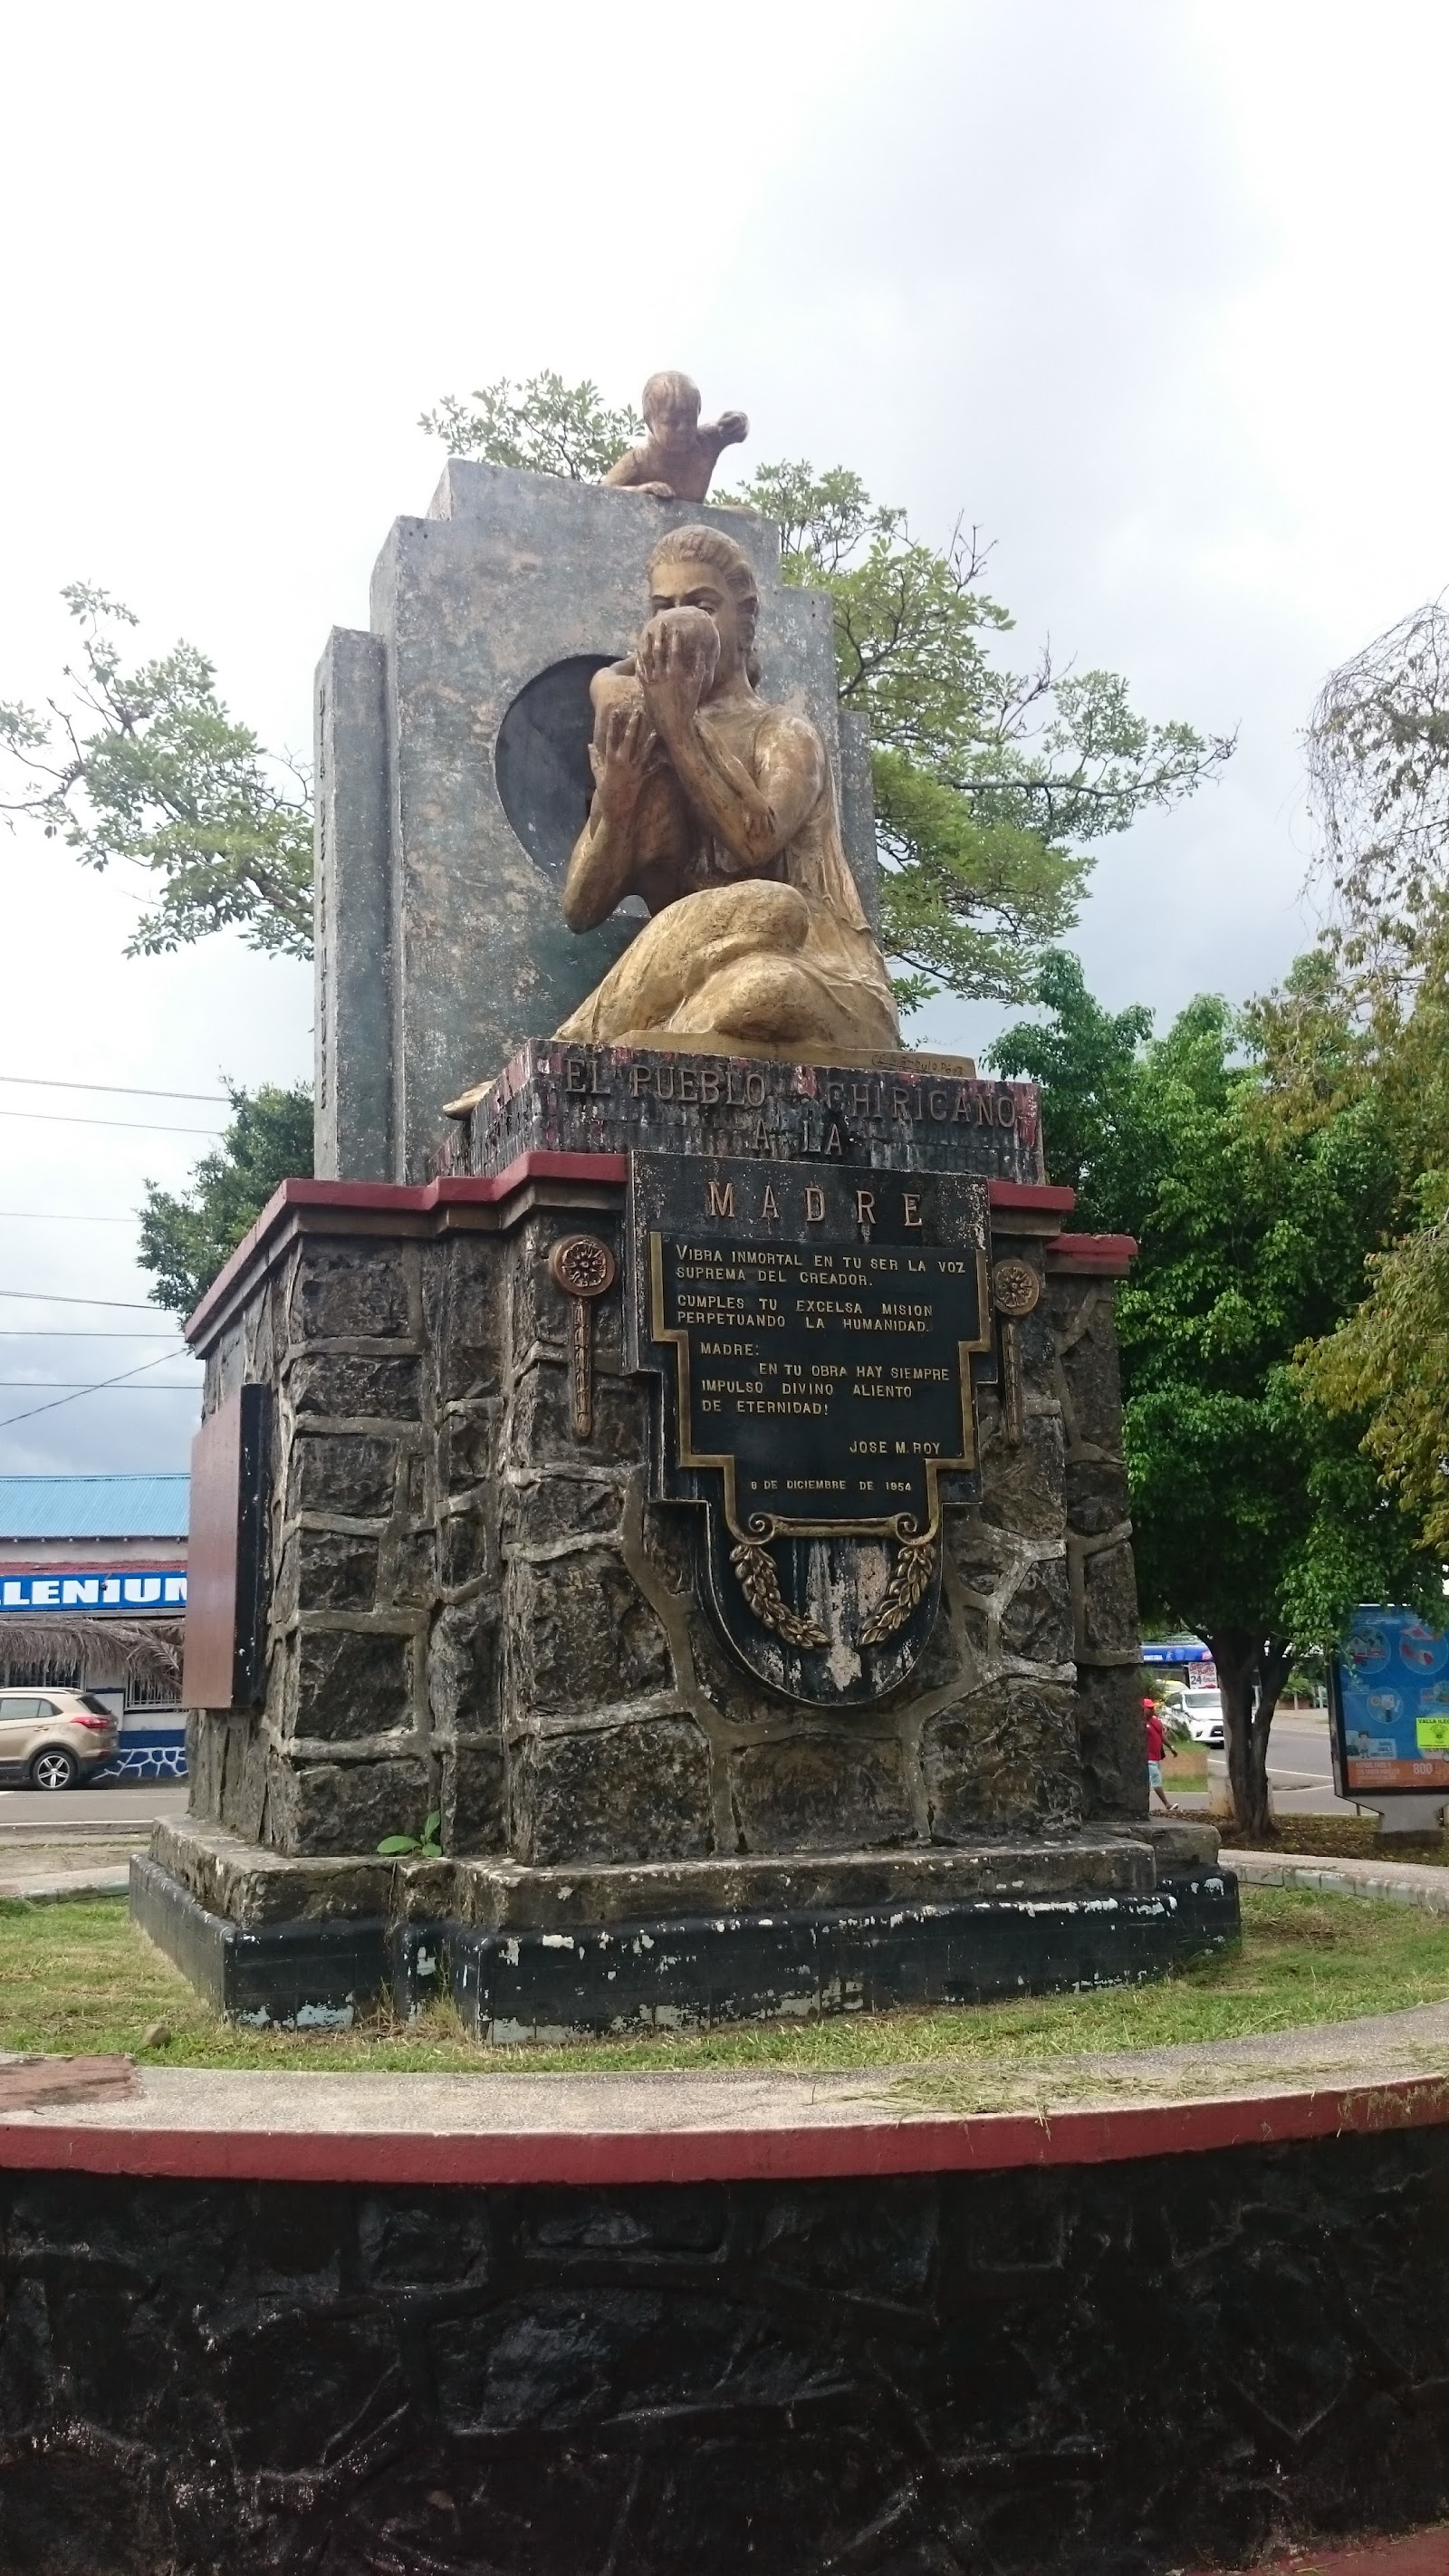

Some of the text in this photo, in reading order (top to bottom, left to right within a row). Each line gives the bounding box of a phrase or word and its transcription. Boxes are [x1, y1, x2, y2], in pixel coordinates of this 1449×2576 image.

[565, 1058, 1016, 1129] EL PUEBLO CHIRICANO
[754, 1118, 842, 1156] A LA
[709, 1181, 924, 1226] MADRE
[676, 1244, 966, 1274] VIBRA INMORTAL EN TU SER LA VOZ
[675, 1266, 873, 1286] SUPREMA DEL CREADOR.
[677, 1294, 933, 1317] CUMPLES TU EXCELSA MISION
[677, 1311, 929, 1332] PERPETUANDO LA HUMANIDAD.
[699, 1341, 759, 1356] MADRE:
[759, 1362, 950, 1381] EN TU OBRA HAY SIEMPRE
[701, 1379, 912, 1398] IMPULSO DIVINO ALIENTO
[702, 1399, 828, 1416] DE ETERNIDAD!
[849, 1440, 888, 1454] JOSE
[912, 1441, 940, 1455] ROY
[763, 1480, 778, 1490] DE
[786, 1479, 846, 1490] DICIEMBRE
[859, 1480, 874, 1491] DE
[886, 1481, 912, 1492] 1954
[0, 1577, 187, 1606] LENIU
[1191, 1676, 1202, 1685] 24
[1413, 1763, 1433, 1774] 800
